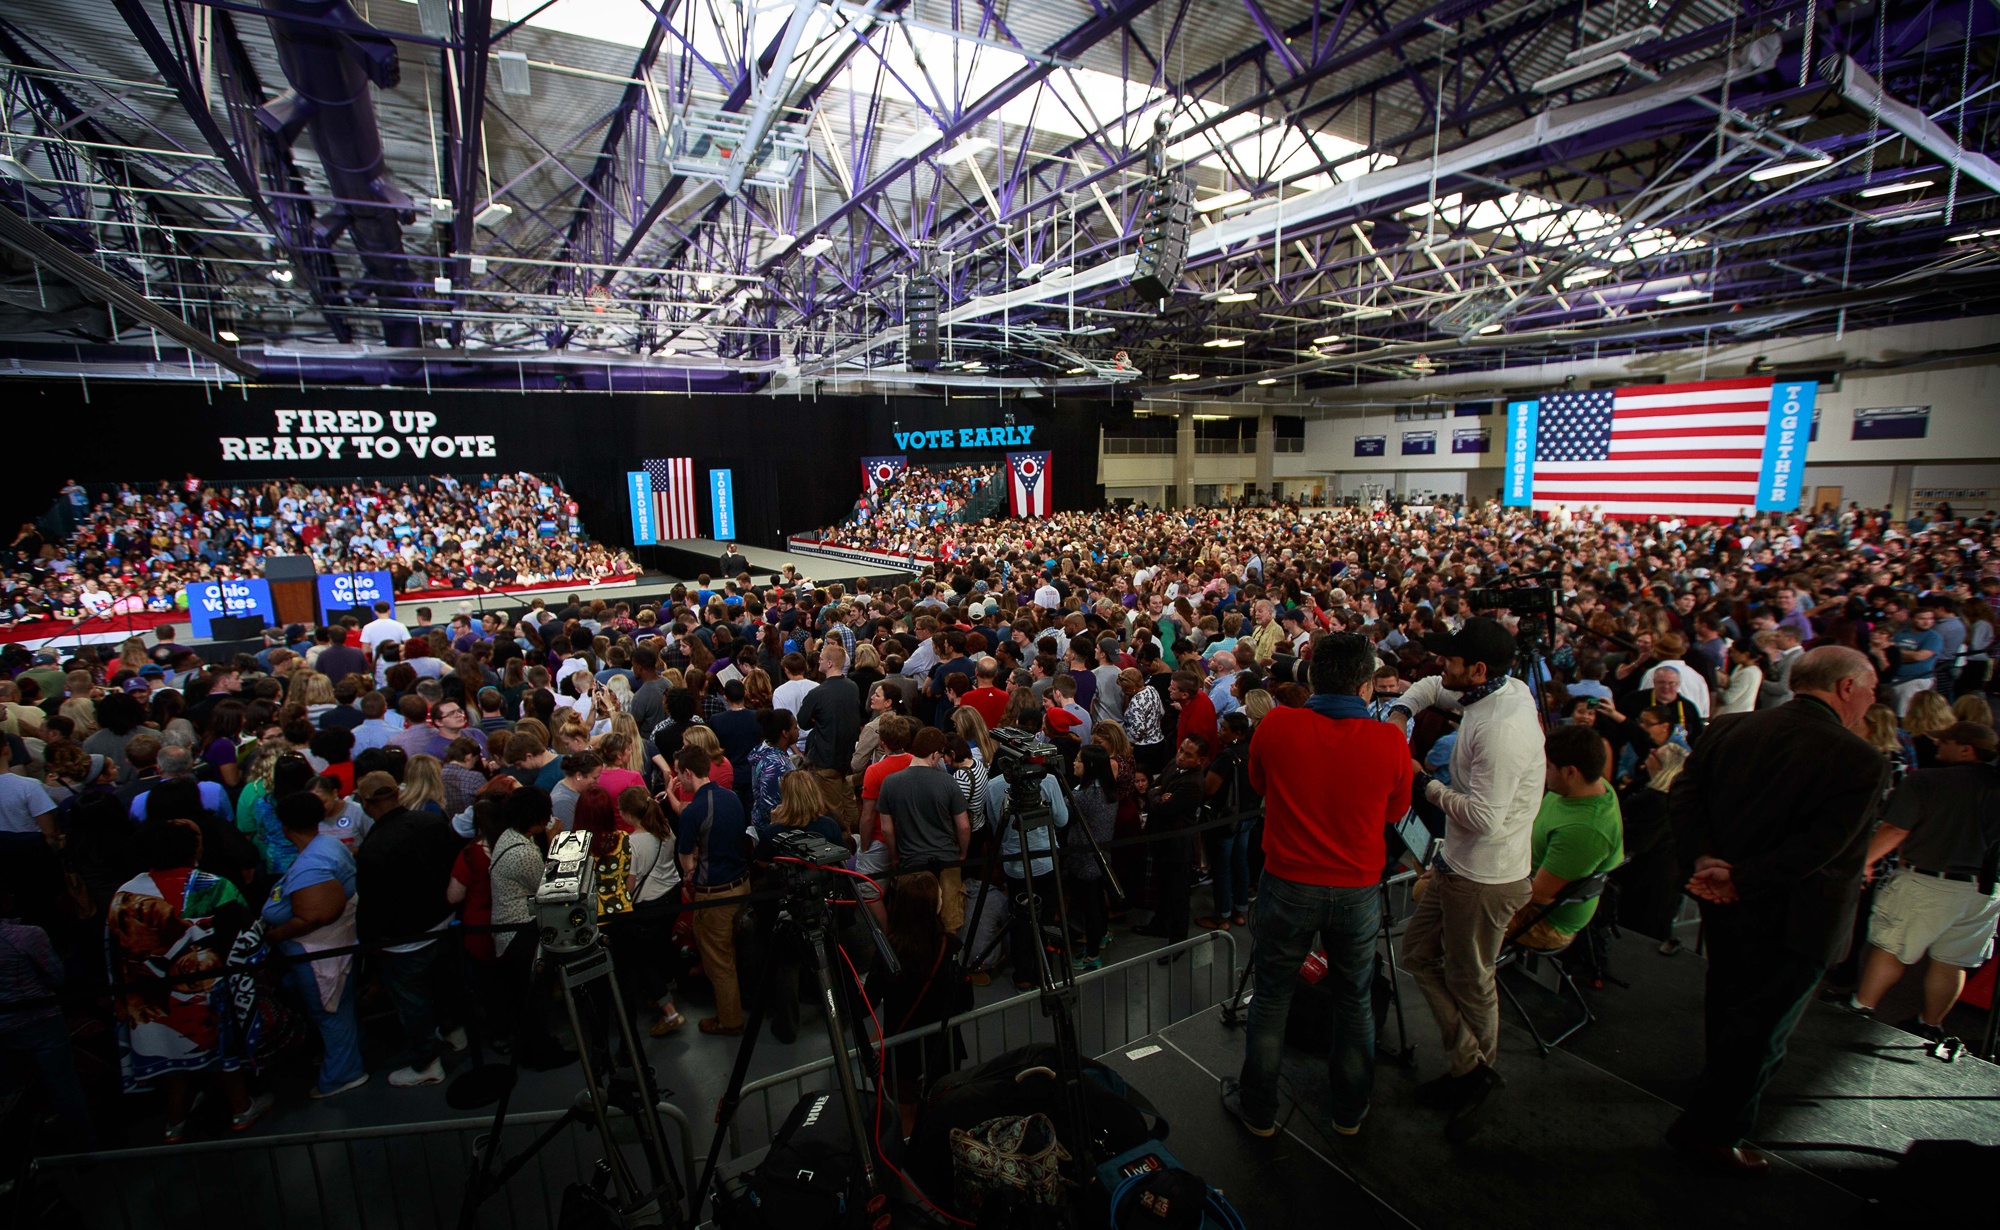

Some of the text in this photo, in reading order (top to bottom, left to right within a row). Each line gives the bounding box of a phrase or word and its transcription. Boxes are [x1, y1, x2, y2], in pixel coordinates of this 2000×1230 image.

[274, 410, 437, 434] FIRED UP
[219, 435, 497, 461] READY TO VOTE
[894, 425, 1035, 450] VOTE EARLY
[1512, 403, 1529, 499] STRONGER
[1770, 385, 1802, 502] TOGETHER
[635, 474, 649, 541] STRONGER
[717, 471, 729, 536] TOGETHER
[205, 583, 250, 599] Ohio
[334, 575, 375, 590] Ohio
[802, 1095, 830, 1128] THULE
